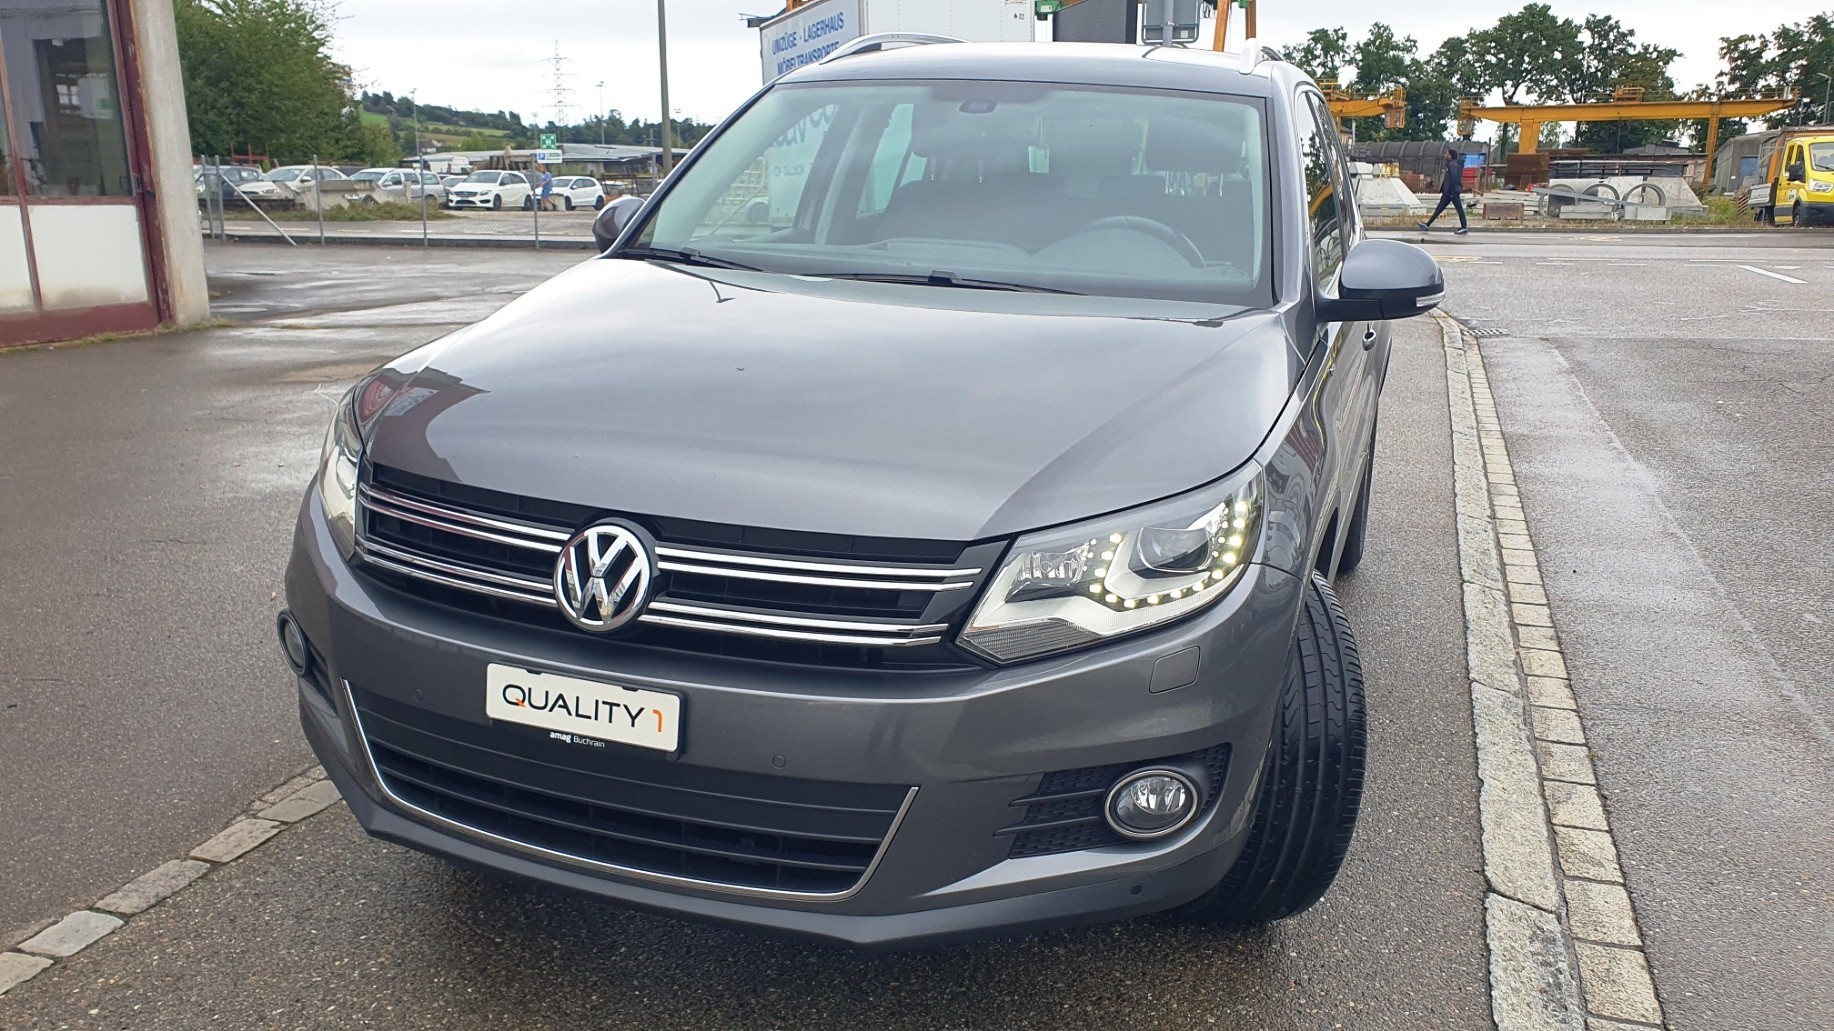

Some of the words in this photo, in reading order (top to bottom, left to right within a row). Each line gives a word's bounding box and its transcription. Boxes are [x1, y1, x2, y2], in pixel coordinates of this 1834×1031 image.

[772, 31, 797, 55] UMZÜGE
[803, 11, 844, 43] LAGERHAUS
[502, 683, 645, 728] QUALITY
[652, 708, 663, 733] 1
[549, 731, 572, 743] amag
[573, 735, 606, 748] Buchrain
